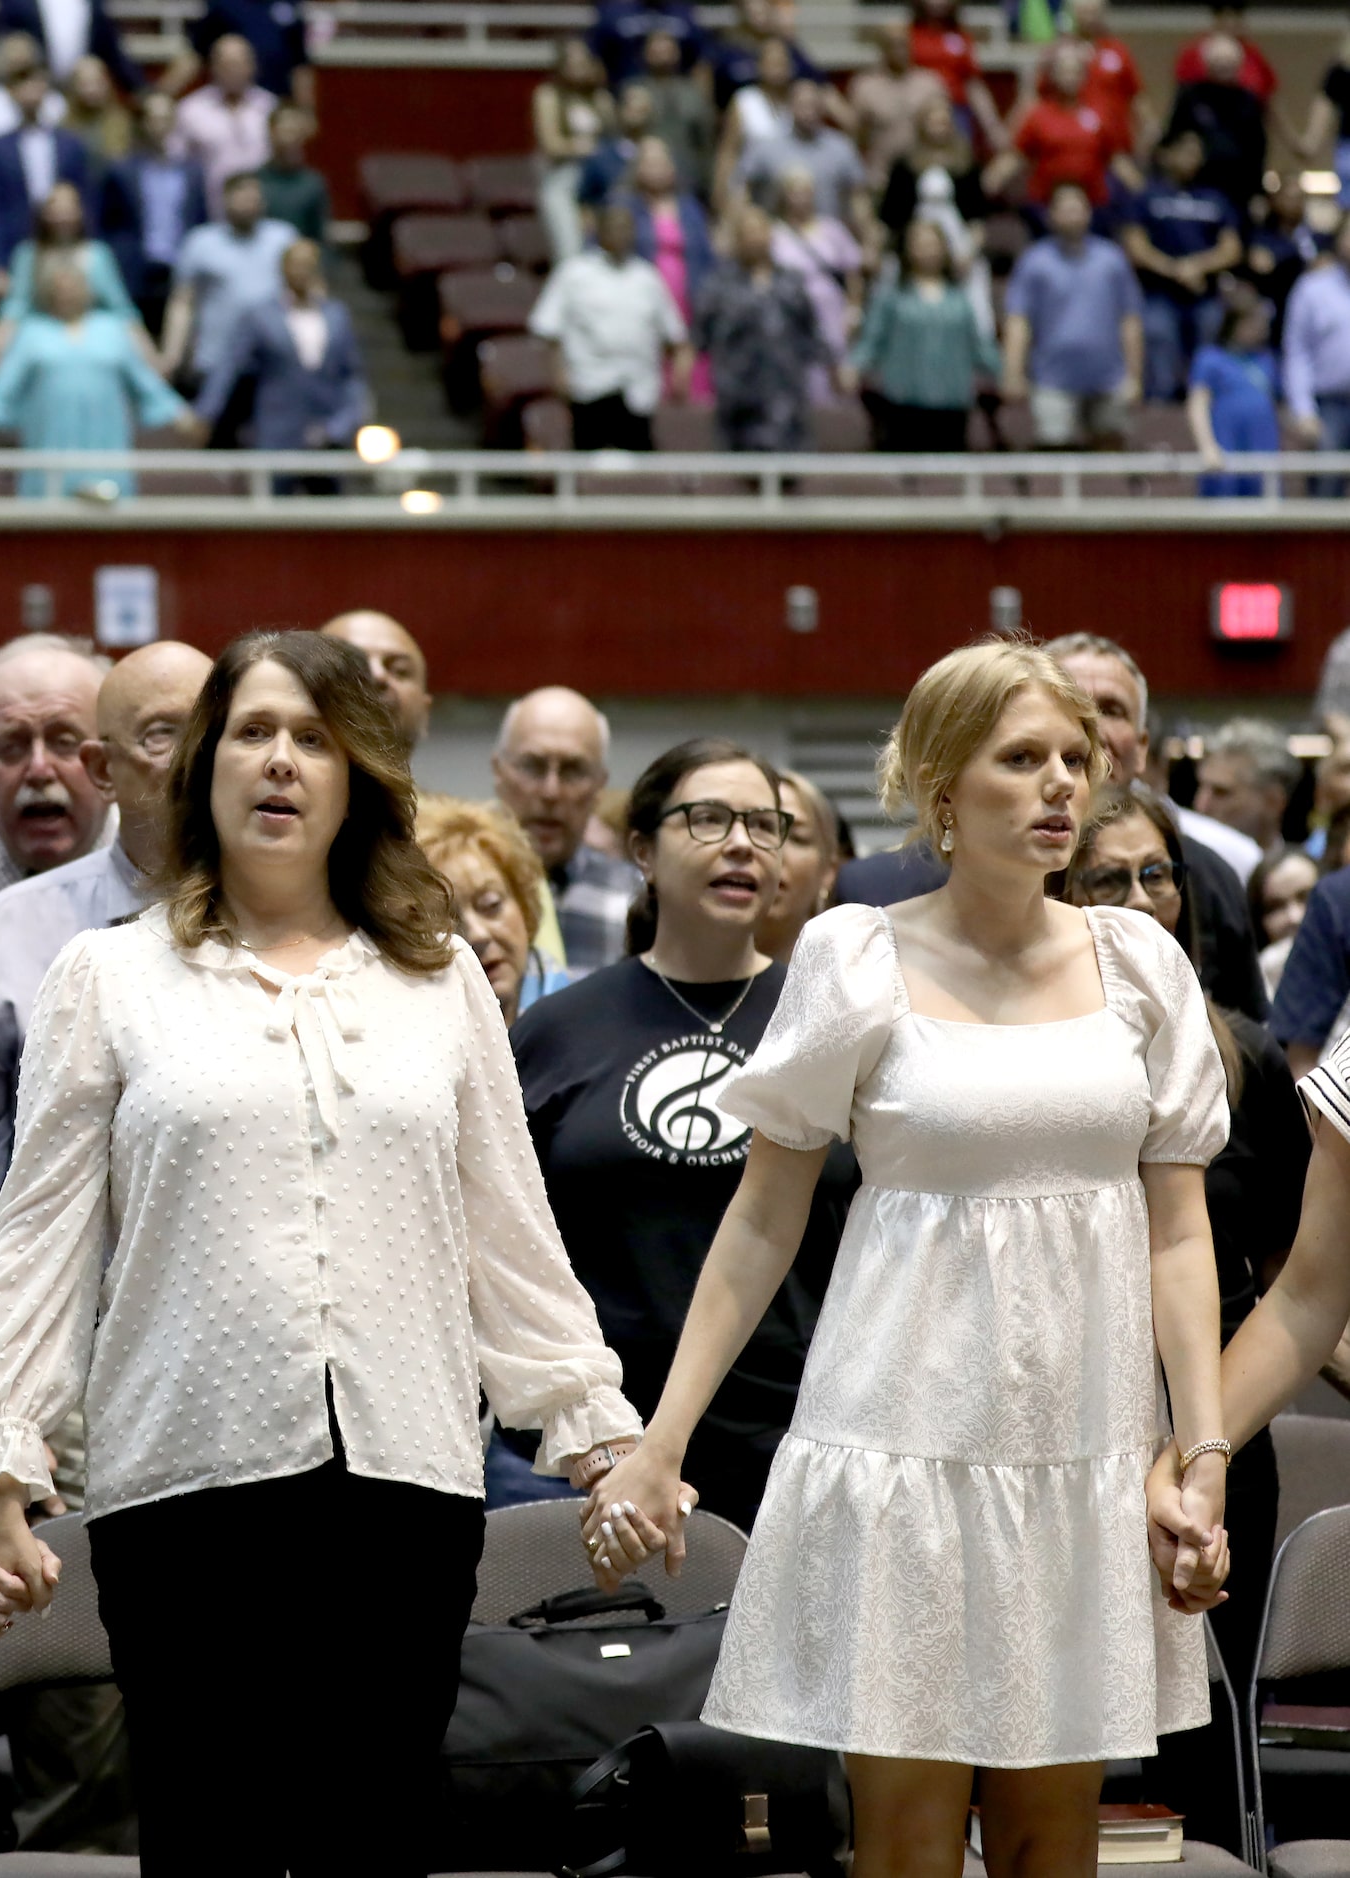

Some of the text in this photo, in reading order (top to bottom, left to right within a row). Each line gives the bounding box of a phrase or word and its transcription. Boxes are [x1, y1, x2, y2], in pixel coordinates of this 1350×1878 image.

[625, 1049, 659, 1083] FIRST
[660, 1034, 725, 1054] BAPTIST
[622, 1123, 663, 1160] CHOIR
[668, 1151, 679, 1165] &
